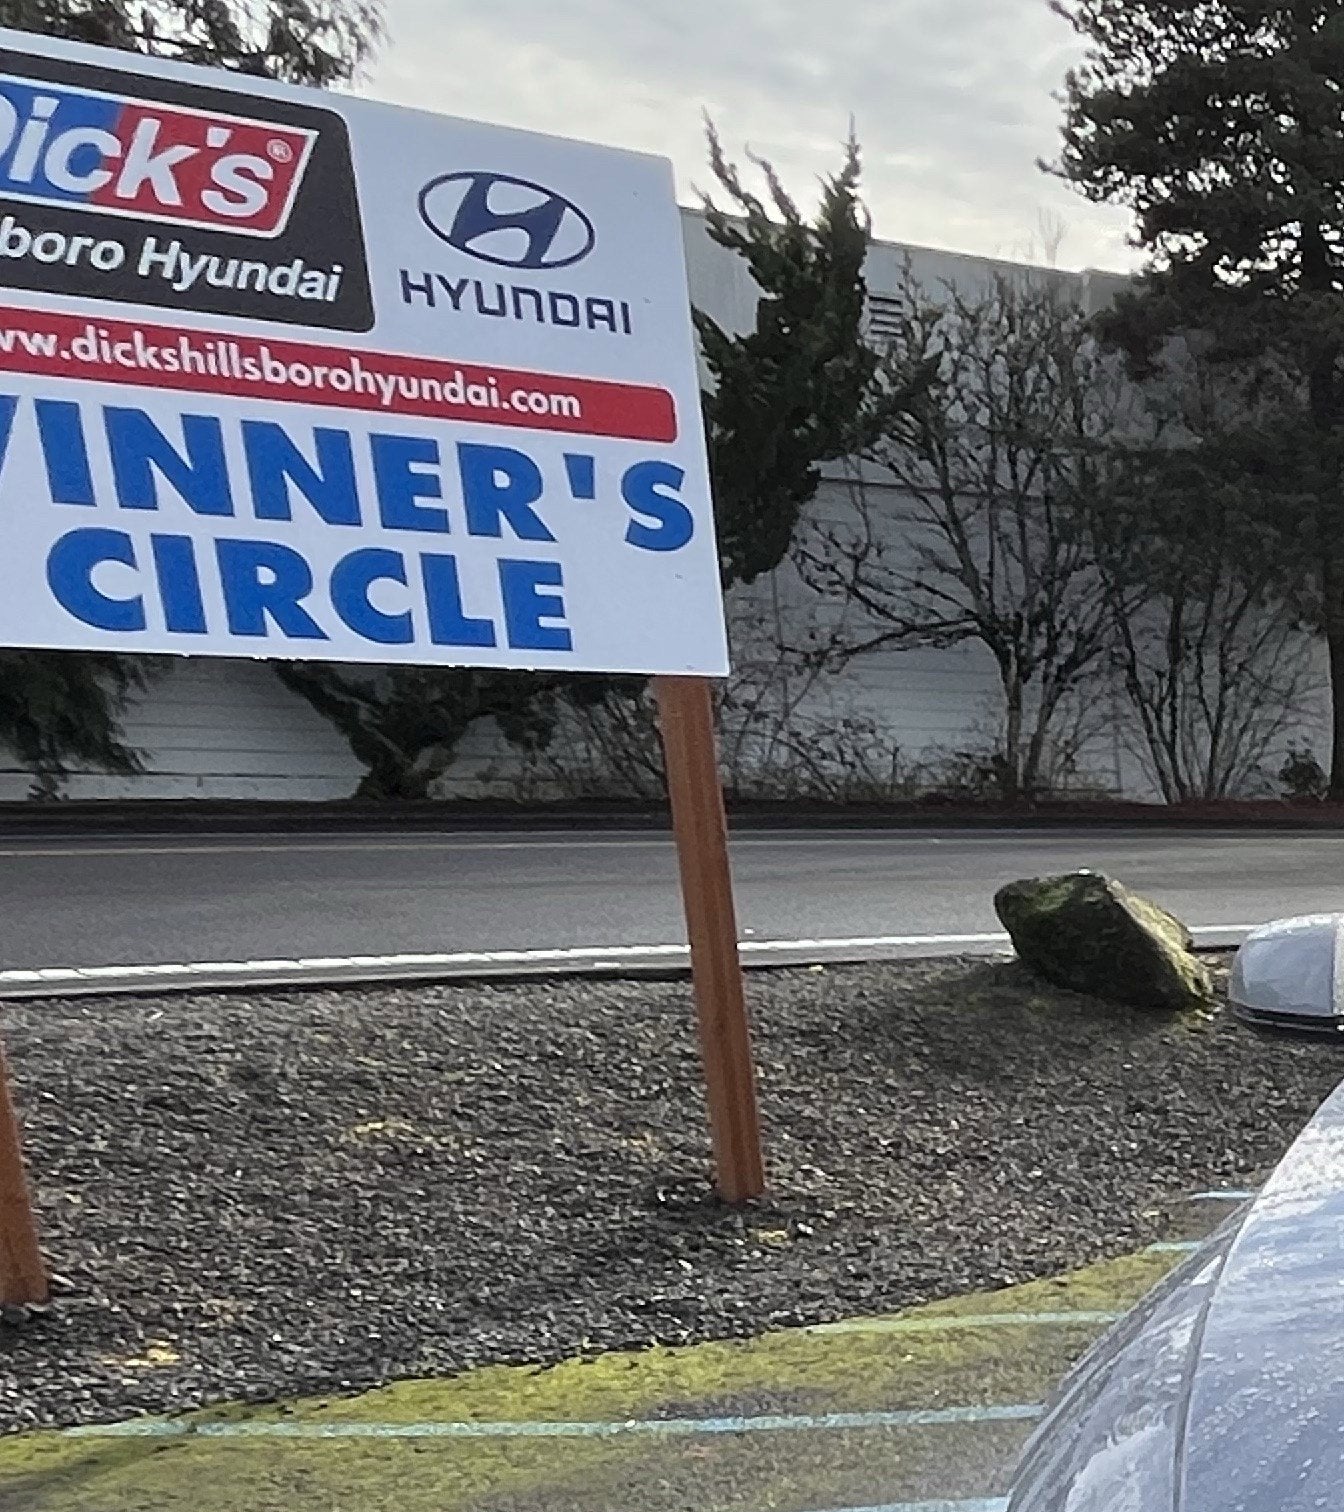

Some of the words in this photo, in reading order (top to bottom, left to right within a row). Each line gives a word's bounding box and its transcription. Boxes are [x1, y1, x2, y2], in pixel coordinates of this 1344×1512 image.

[138, 236, 343, 302] Hyundai
[400, 270, 632, 335] HYUNDAI
[0, 394, 694, 552] INNER'S
[46, 527, 573, 652] CIRCLE
